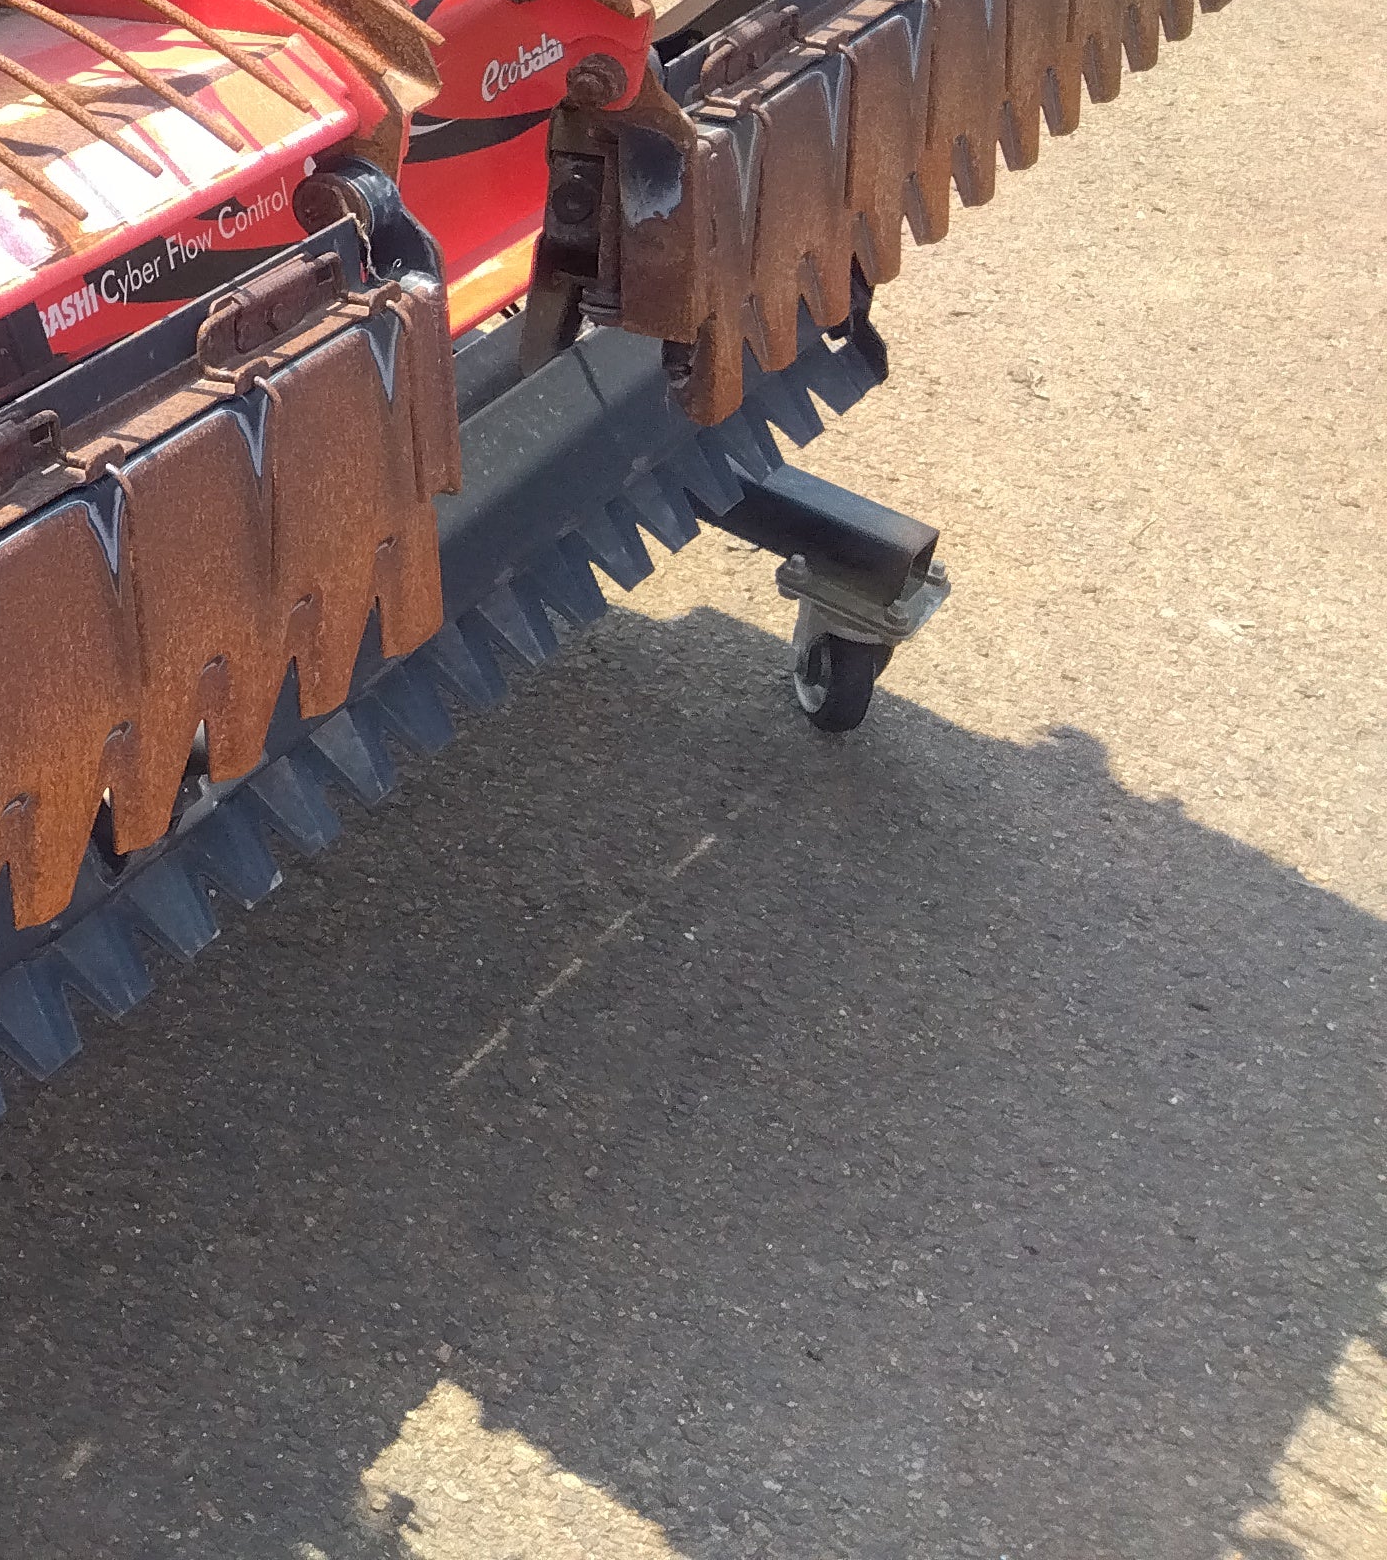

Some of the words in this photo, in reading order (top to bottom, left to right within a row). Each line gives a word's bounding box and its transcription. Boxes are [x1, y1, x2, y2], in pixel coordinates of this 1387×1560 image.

[100, 254, 162, 306] Cyber
[165, 227, 213, 271] Flow
[217, 176, 290, 239] Control
